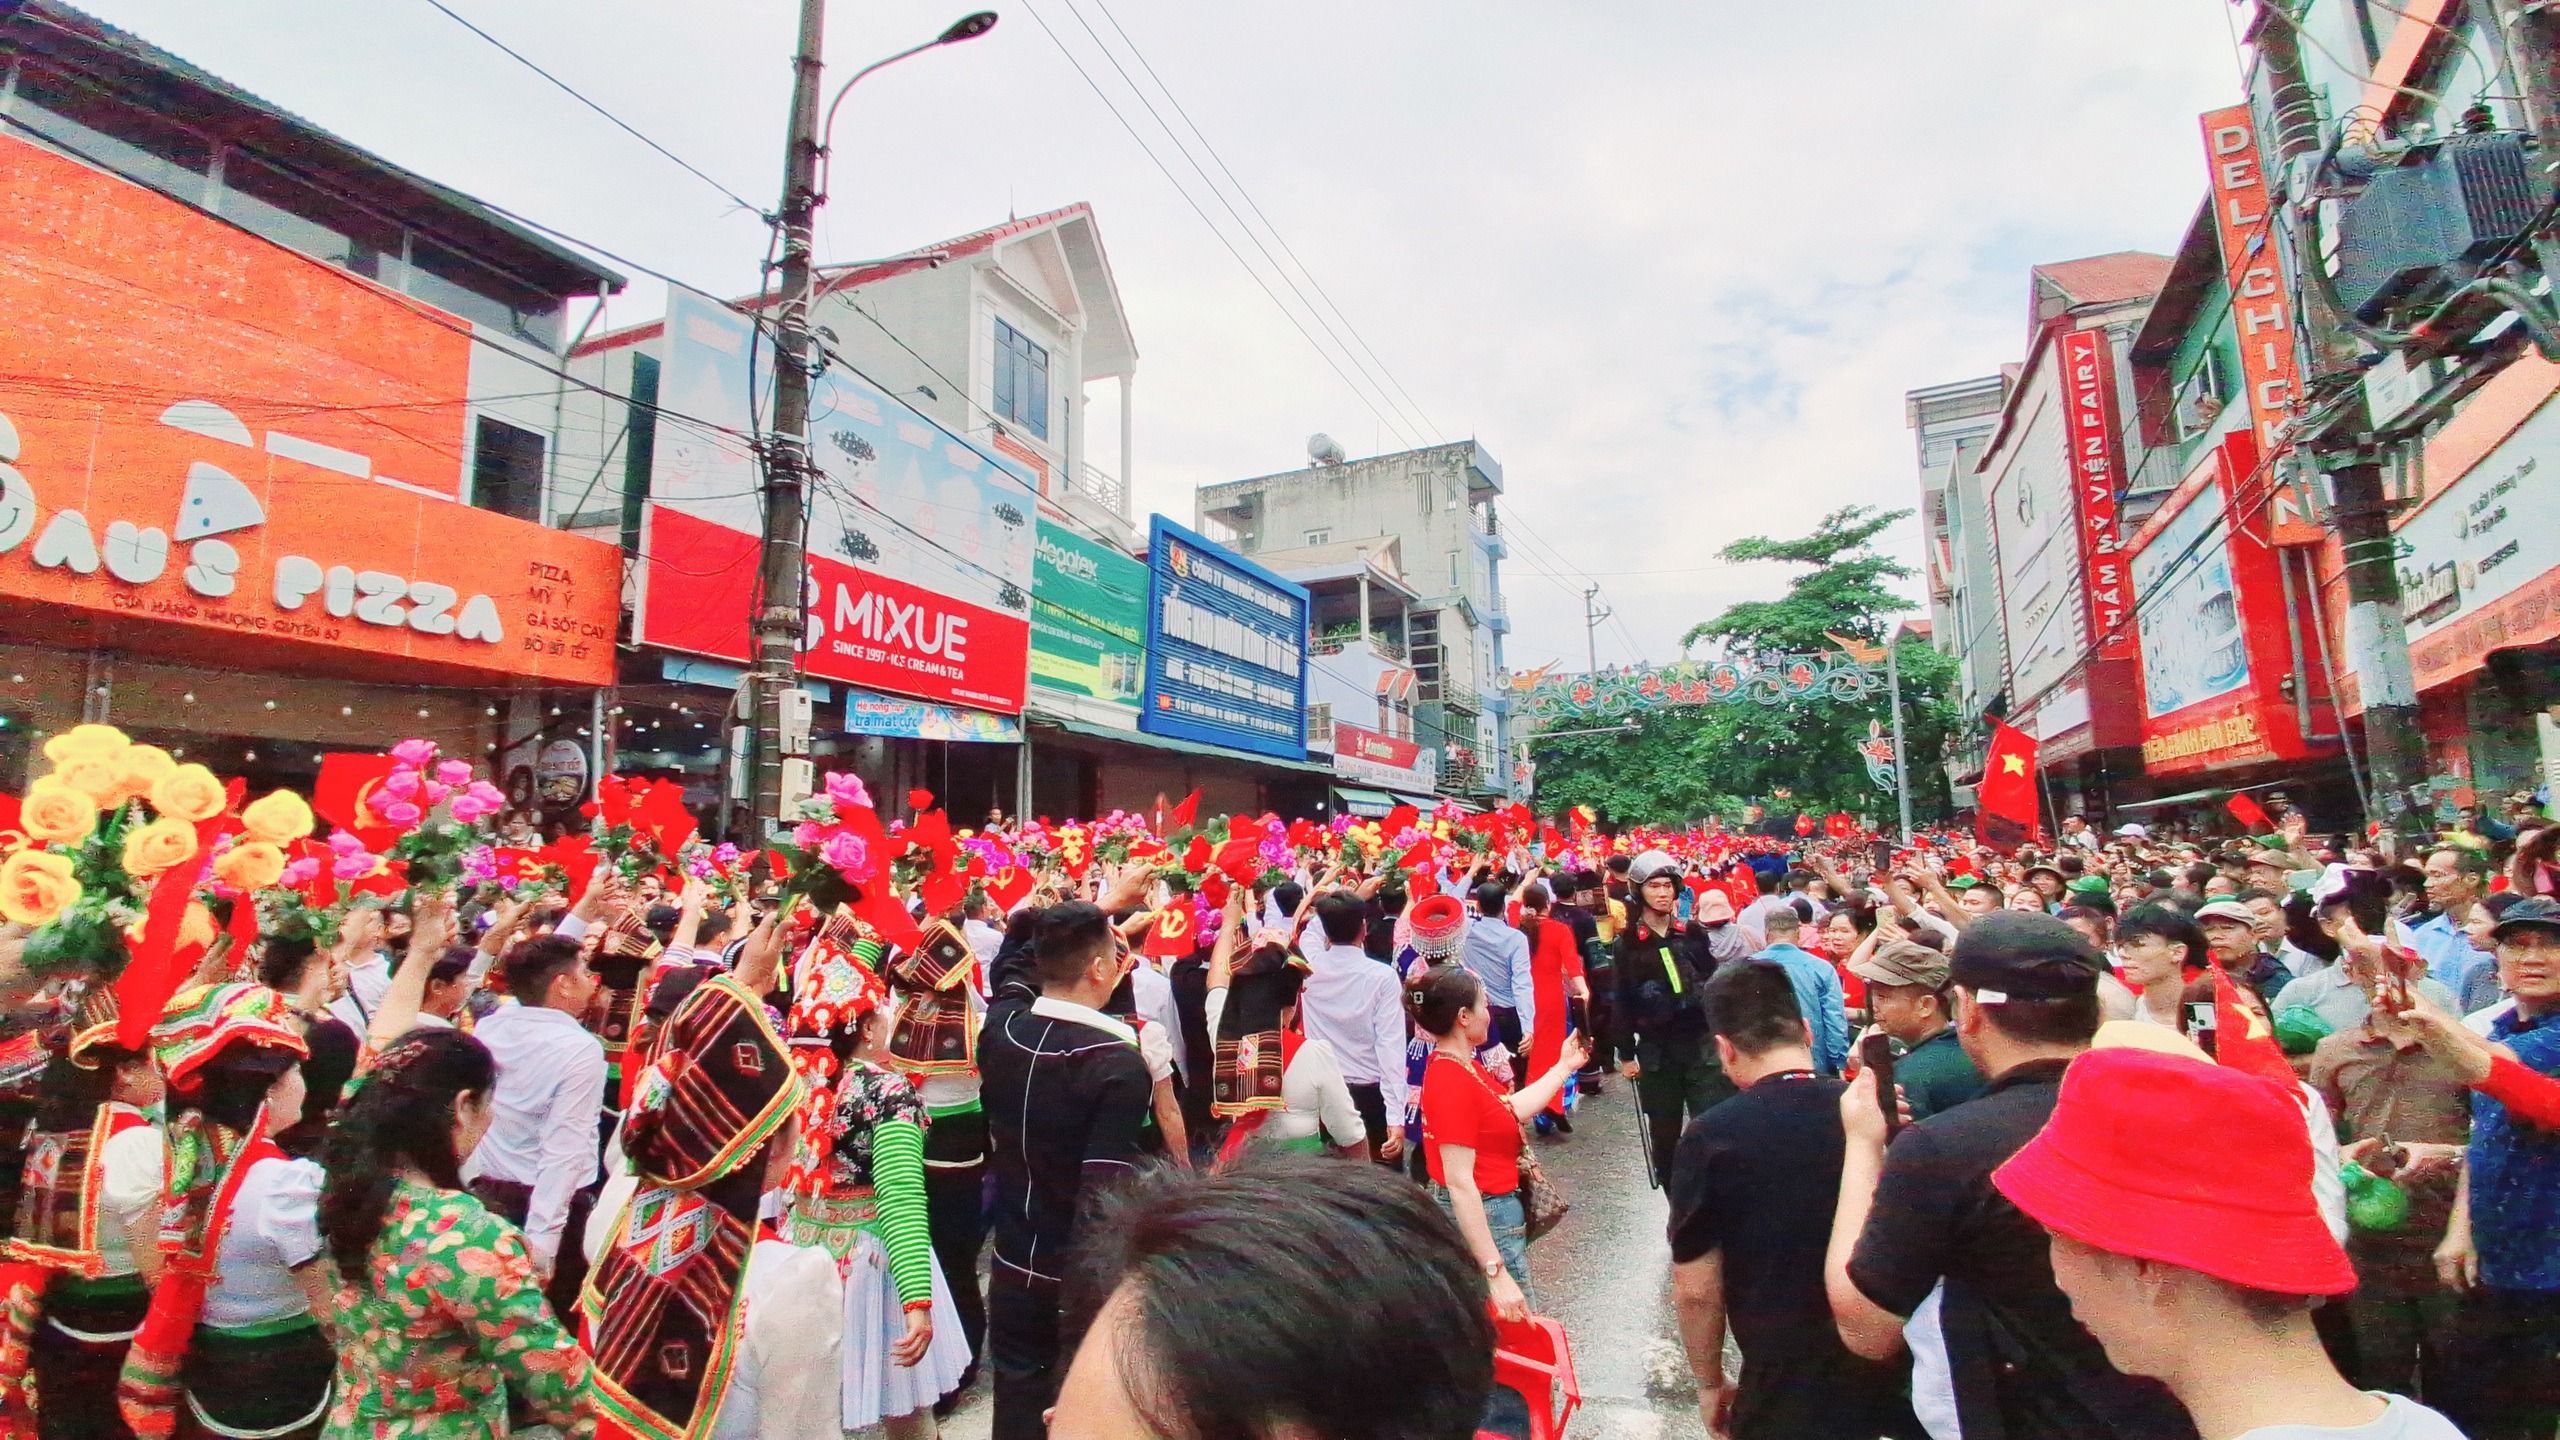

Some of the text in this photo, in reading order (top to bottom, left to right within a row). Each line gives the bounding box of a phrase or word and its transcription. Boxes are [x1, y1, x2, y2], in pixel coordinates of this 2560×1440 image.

[2075, 345, 2102, 427] FAIRY
[274, 555, 504, 643] PIZZA
[529, 562, 574, 586] PIZZA
[832, 639, 865, 659] SINCE
[865, 647, 886, 664] 1997
[890, 653, 907, 668] ICE
[834, 582, 968, 662] MIXUE
